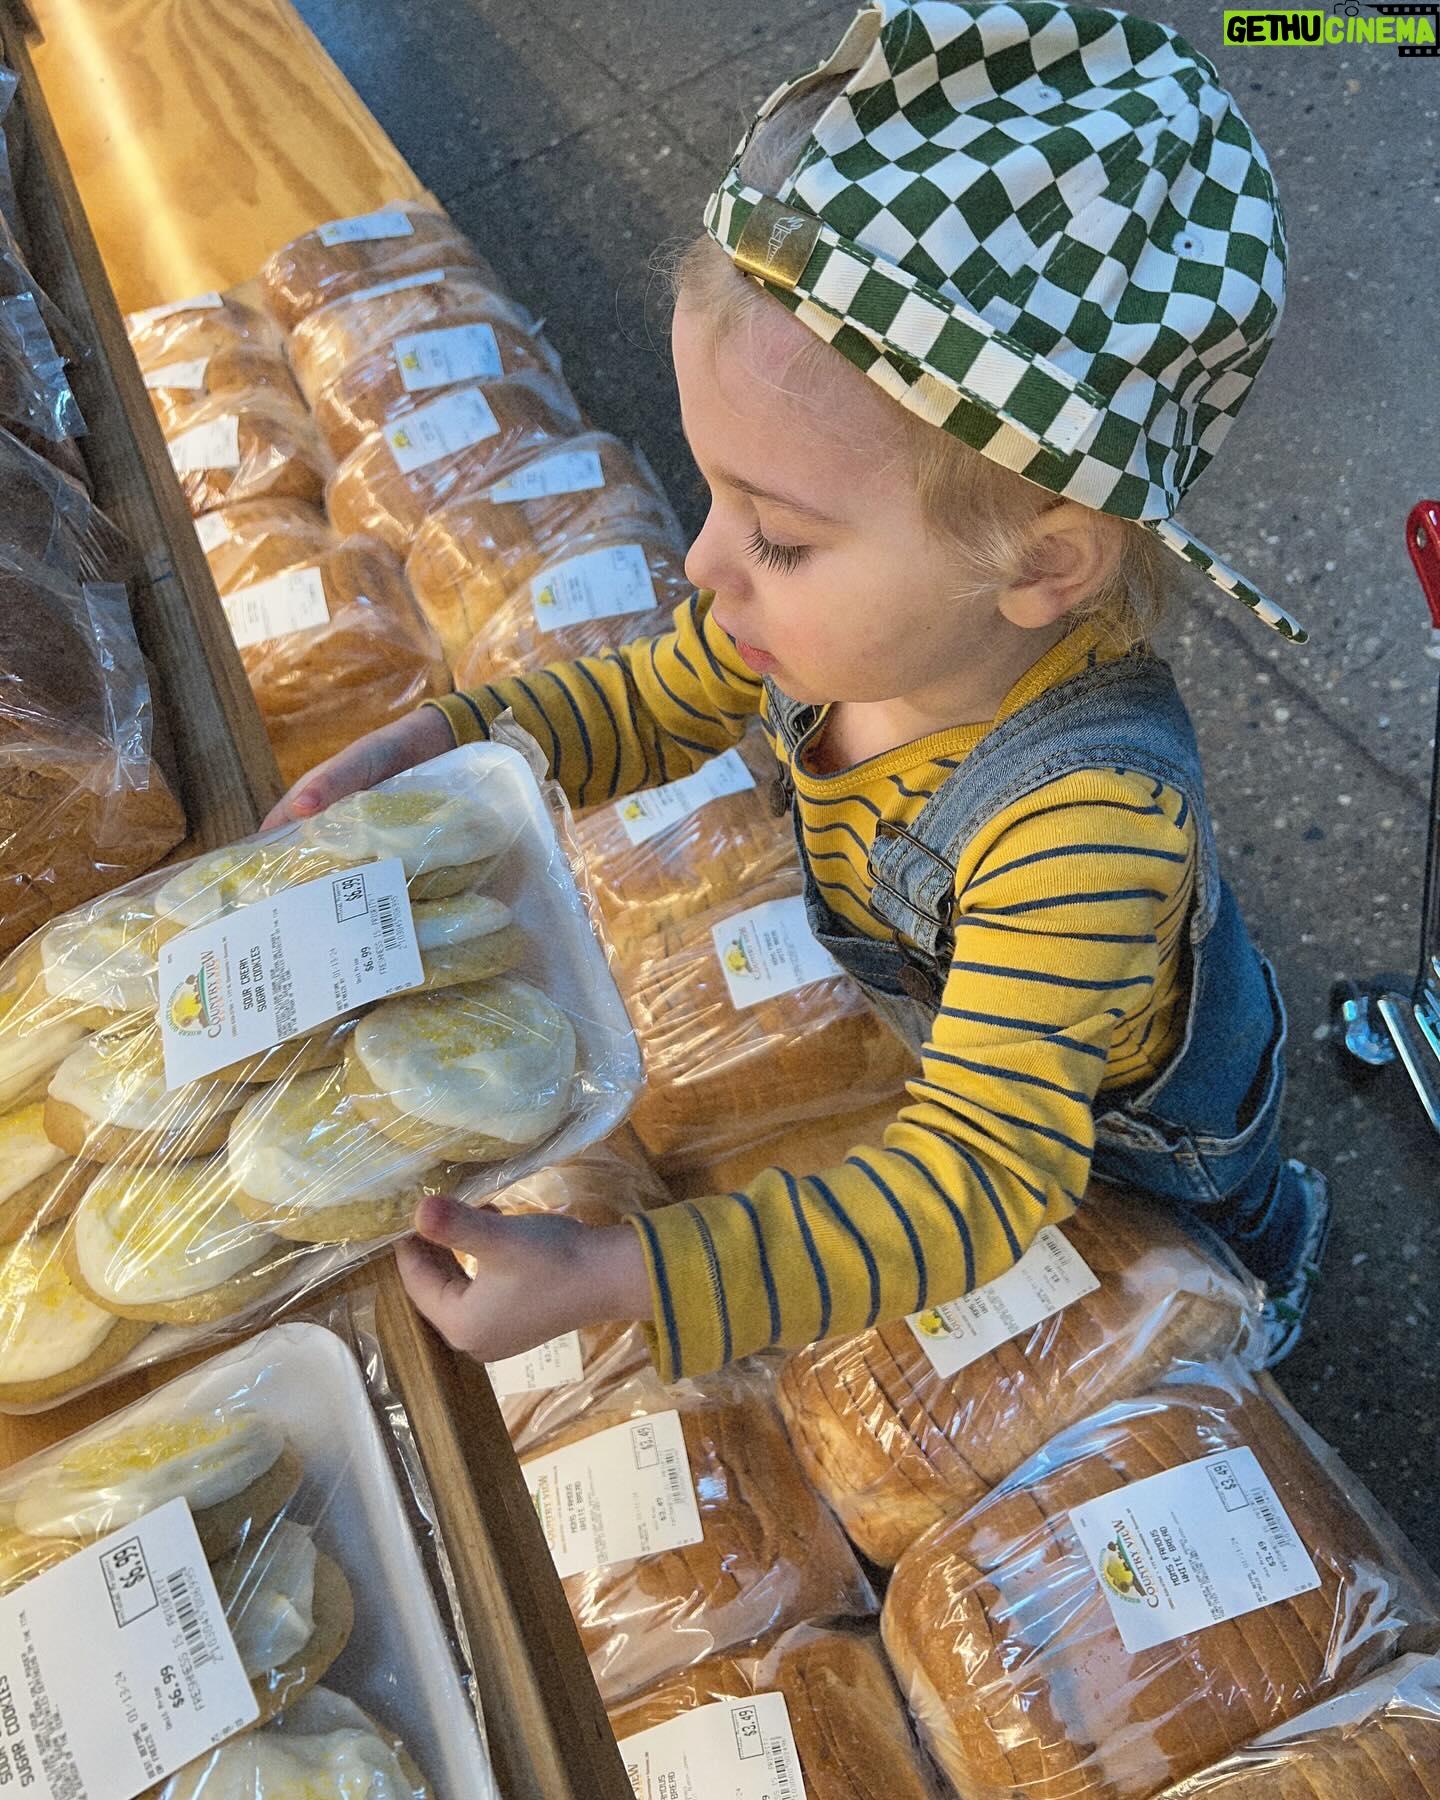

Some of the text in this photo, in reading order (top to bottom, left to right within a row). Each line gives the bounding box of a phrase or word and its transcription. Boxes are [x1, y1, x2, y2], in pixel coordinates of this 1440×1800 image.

[341, 875, 363, 903] $6.99
[200, 947, 216, 978] VIEW
[250, 944, 266, 1013] SUGAR COOKIES
[360, 944, 374, 973] $6.99
[238, 957, 253, 1010] SOUR CREAM
[206, 979, 222, 1039] COUNTRY
[1212, 1463, 1238, 1491] $3.49
[1110, 1517, 1134, 1548] VIEW
[1149, 1528, 1181, 1586] MOMS FAMOUS
[1158, 1525, 1190, 1583] WHITE BREAD
[1256, 1539, 1276, 1567] $3.49
[111, 1542, 147, 1591] $6.99
[1129, 1549, 1161, 1609] COUNTRY
[152, 1577, 178, 1627] PRIORITY
[159, 1662, 185, 1710] $6.99
[176, 1650, 206, 1713] FRESHNESS
[0, 1673, 35, 1788] SUGAR COOKIES
[738, 1707, 757, 1738] $3.49
[667, 1770, 678, 1800] BREAD
